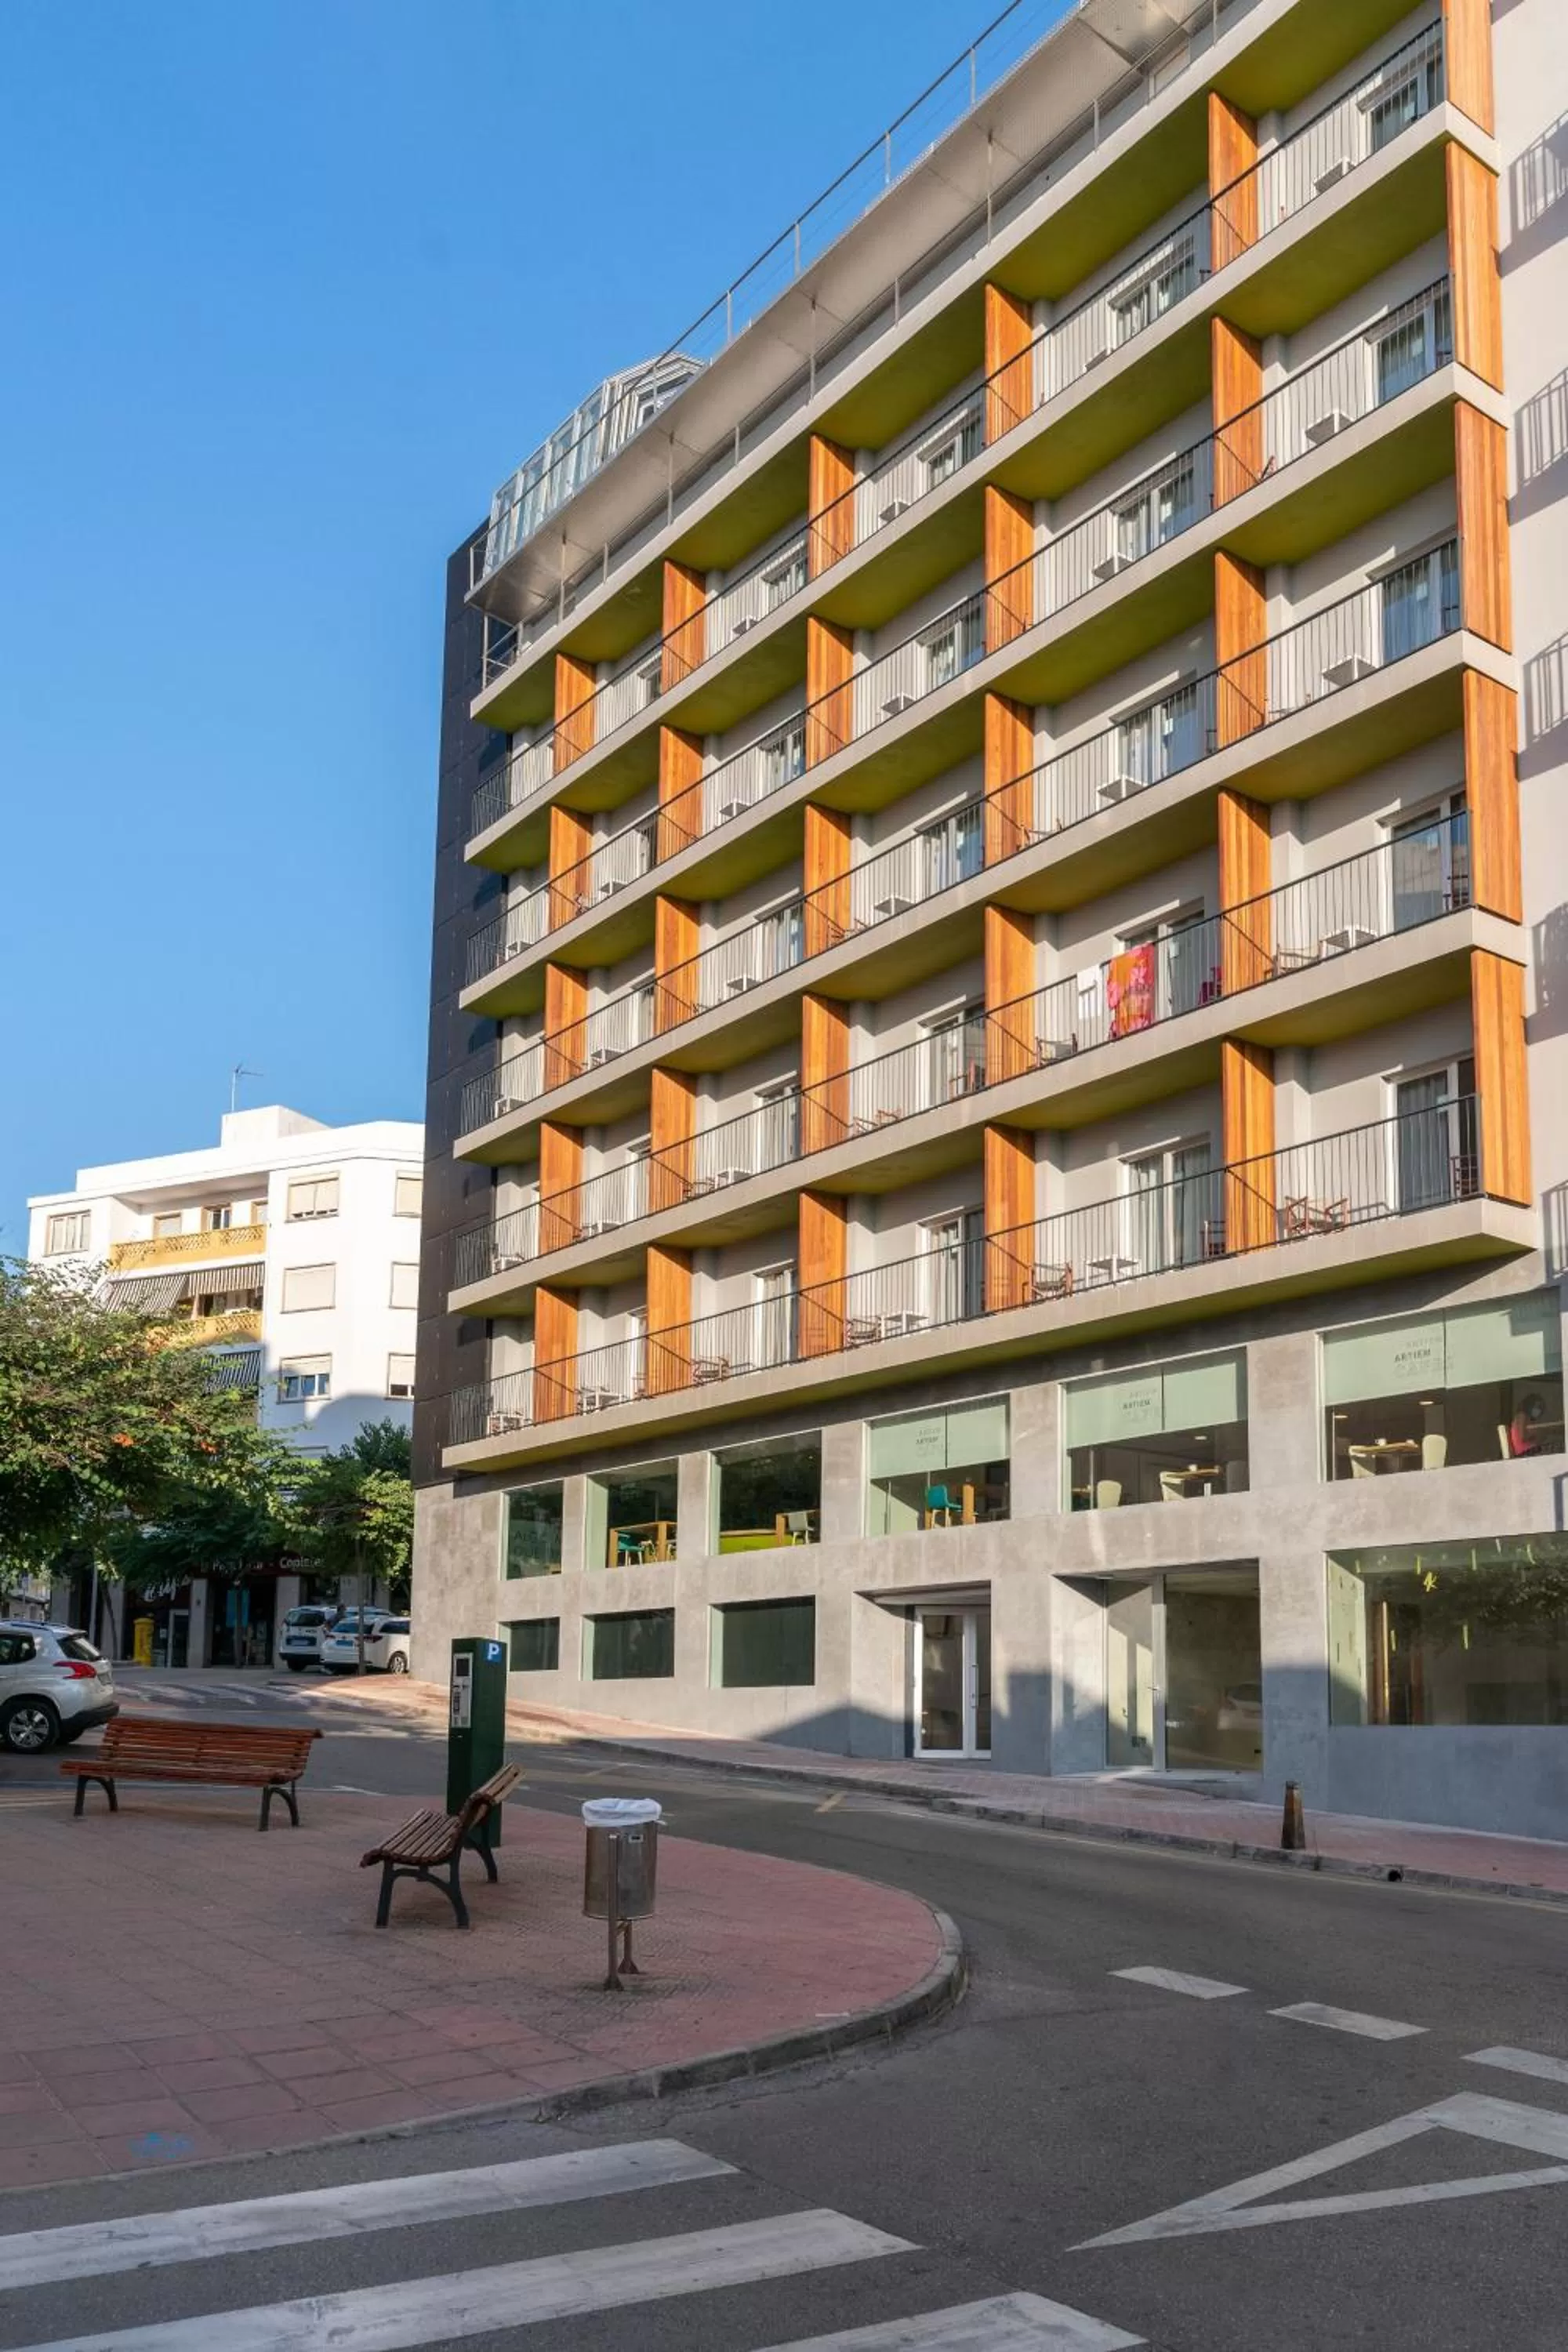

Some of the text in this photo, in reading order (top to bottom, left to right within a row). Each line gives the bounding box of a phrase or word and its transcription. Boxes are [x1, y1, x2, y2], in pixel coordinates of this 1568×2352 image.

[1394, 1348, 1431, 1363] ARTIEM
[1123, 1399, 1151, 1410] ARTIEM
[487, 1642, 500, 1661] P
